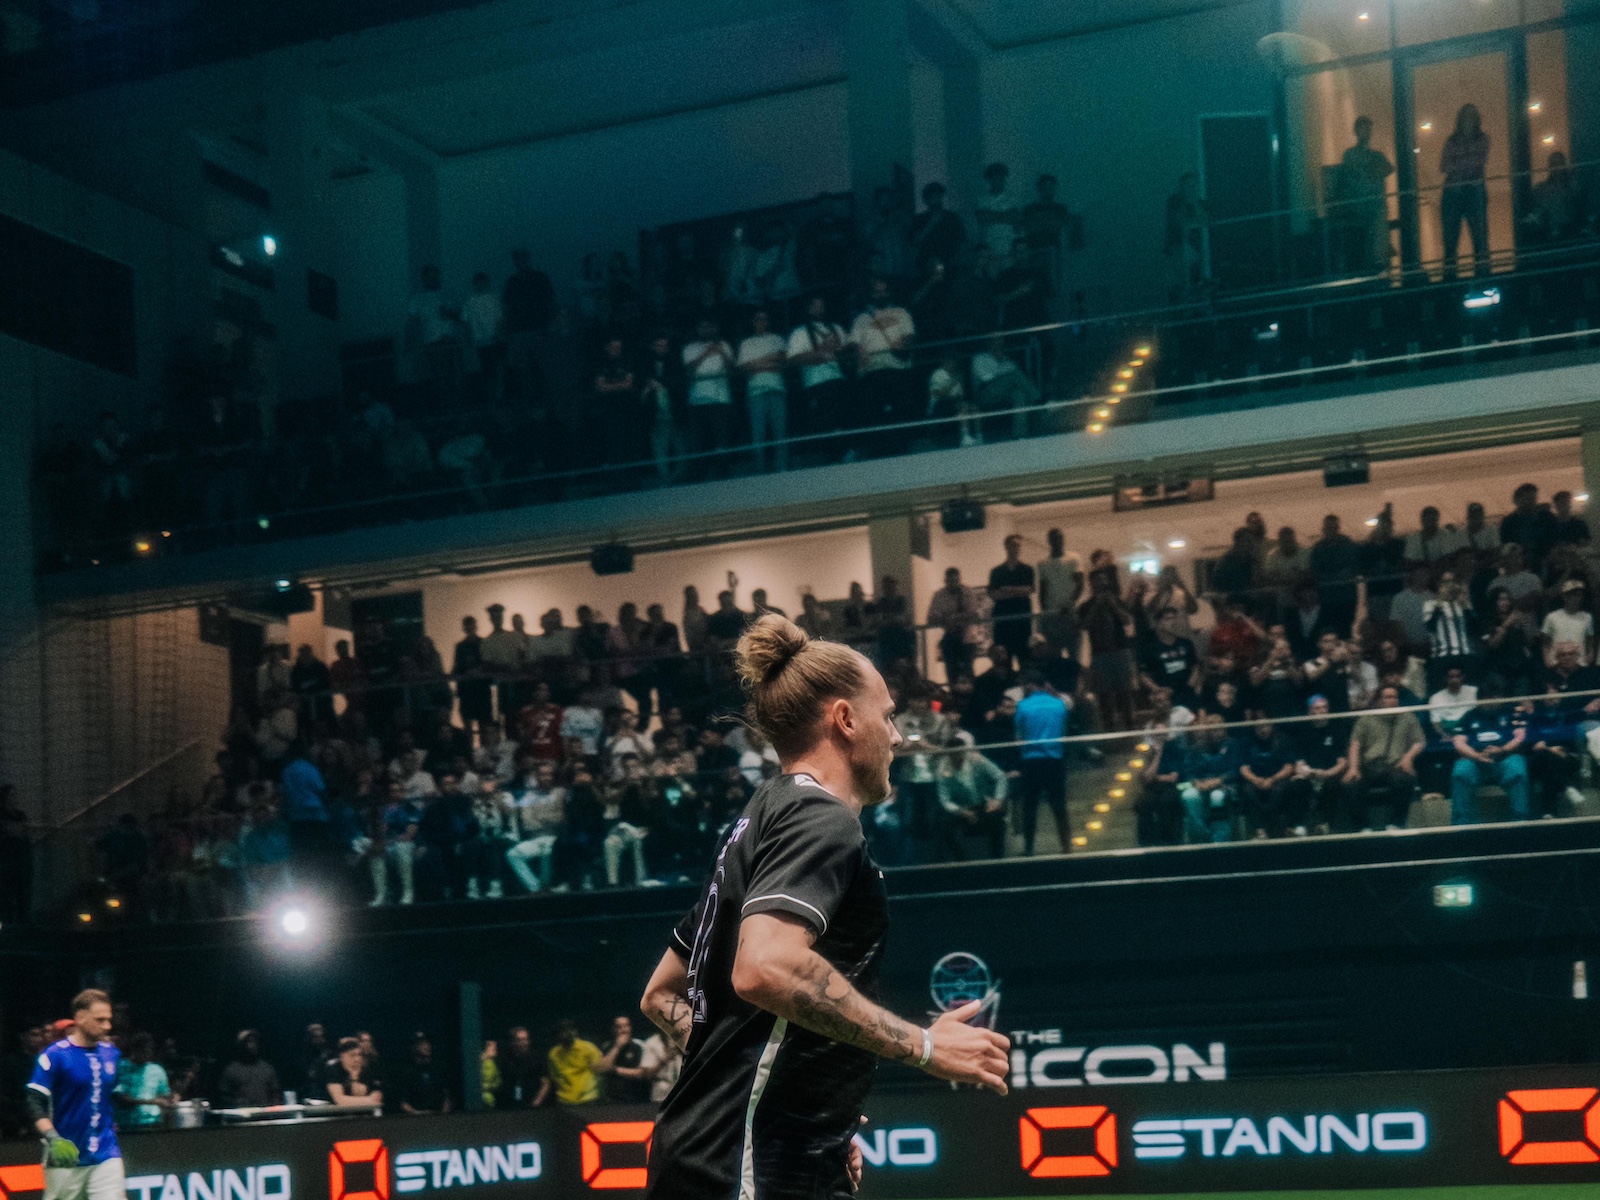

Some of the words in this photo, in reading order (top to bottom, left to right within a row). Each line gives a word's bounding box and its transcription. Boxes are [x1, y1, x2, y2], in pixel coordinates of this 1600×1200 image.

[1011, 1028, 1062, 1045] THE
[1011, 1042, 1226, 1088] ICON
[1132, 1111, 1426, 1158] STANNO
[395, 1142, 542, 1192] STANNO
